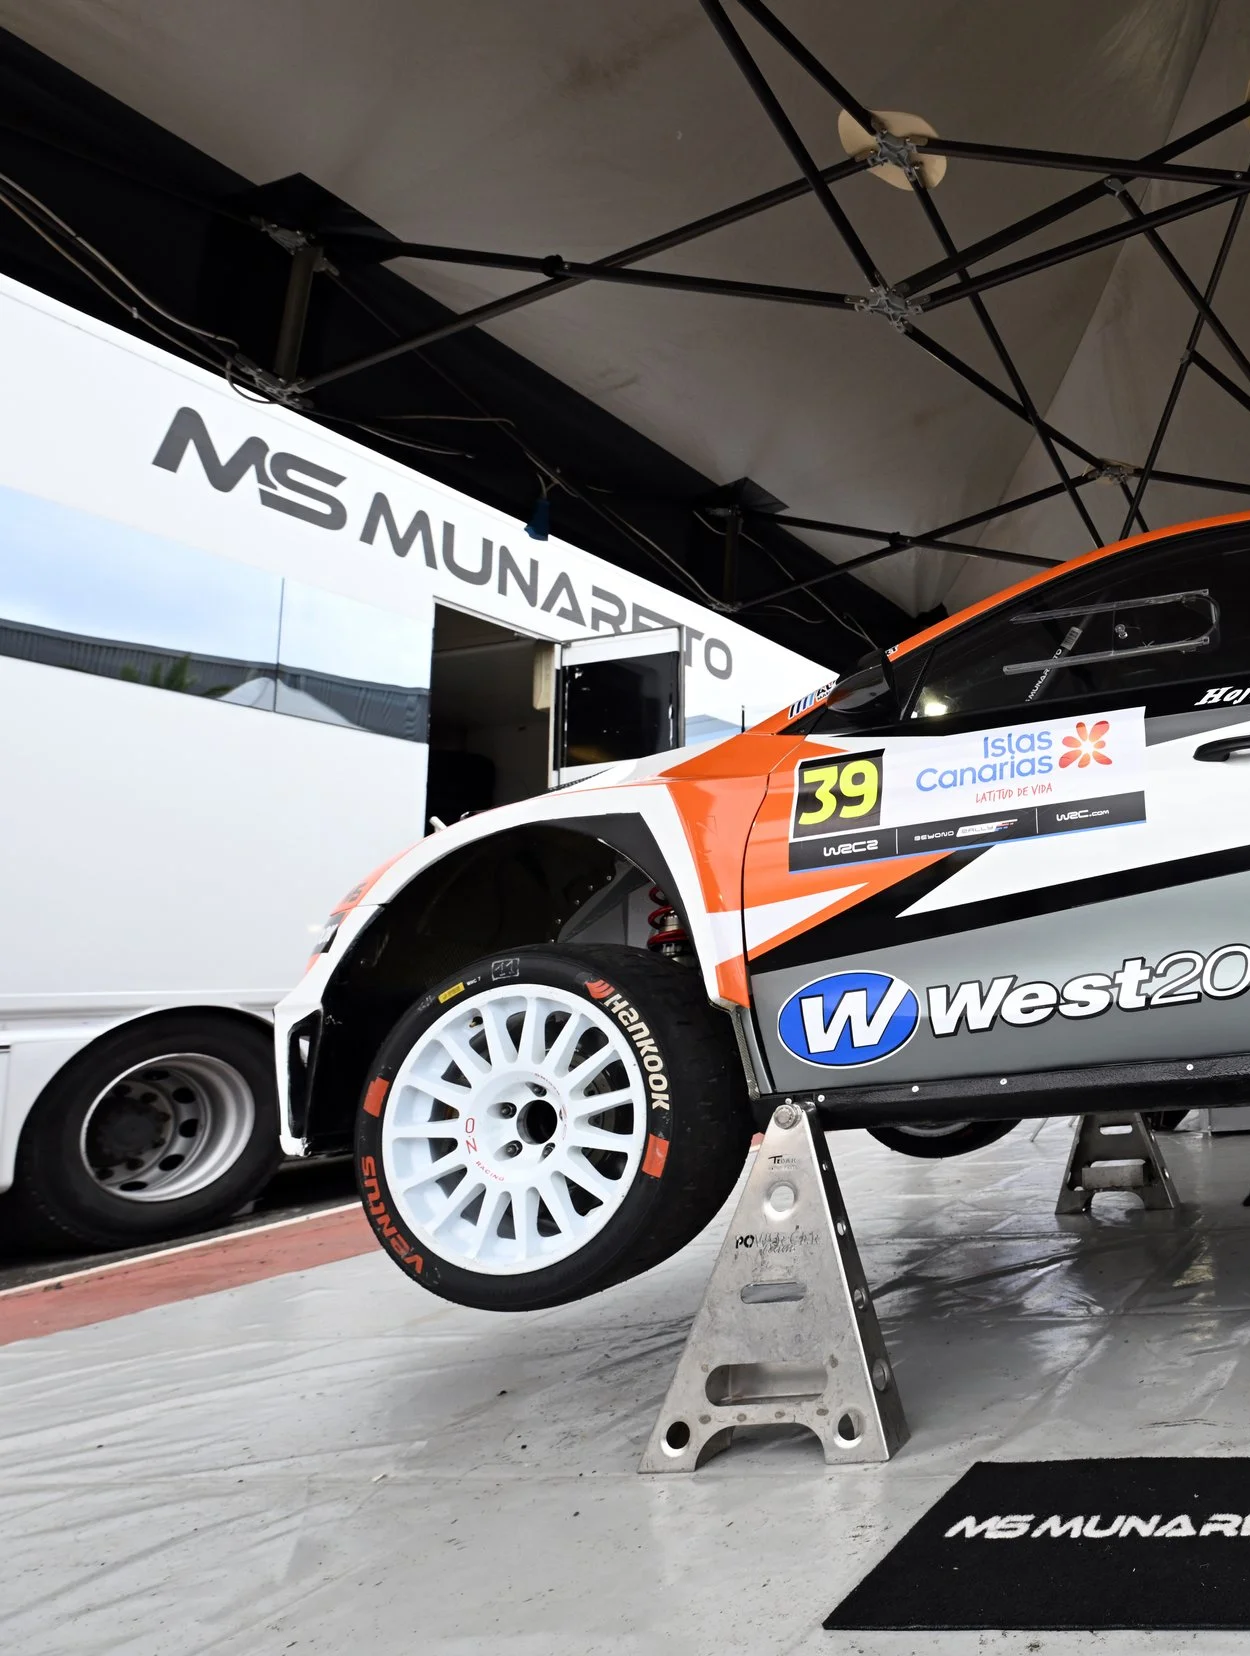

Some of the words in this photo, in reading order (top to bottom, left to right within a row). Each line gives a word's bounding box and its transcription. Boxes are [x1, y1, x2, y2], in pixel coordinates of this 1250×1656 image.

[153, 406, 347, 531] MS
[983, 731, 1054, 760] Islas
[915, 755, 1054, 792] Canarias
[798, 760, 879, 825] 39
[1017, 786, 1029, 797] DE
[1031, 783, 1053, 795] VIDA
[823, 839, 879, 857] WRC2
[475, 1160, 505, 1182] RACING
[944, 1513, 1033, 1539] MS
